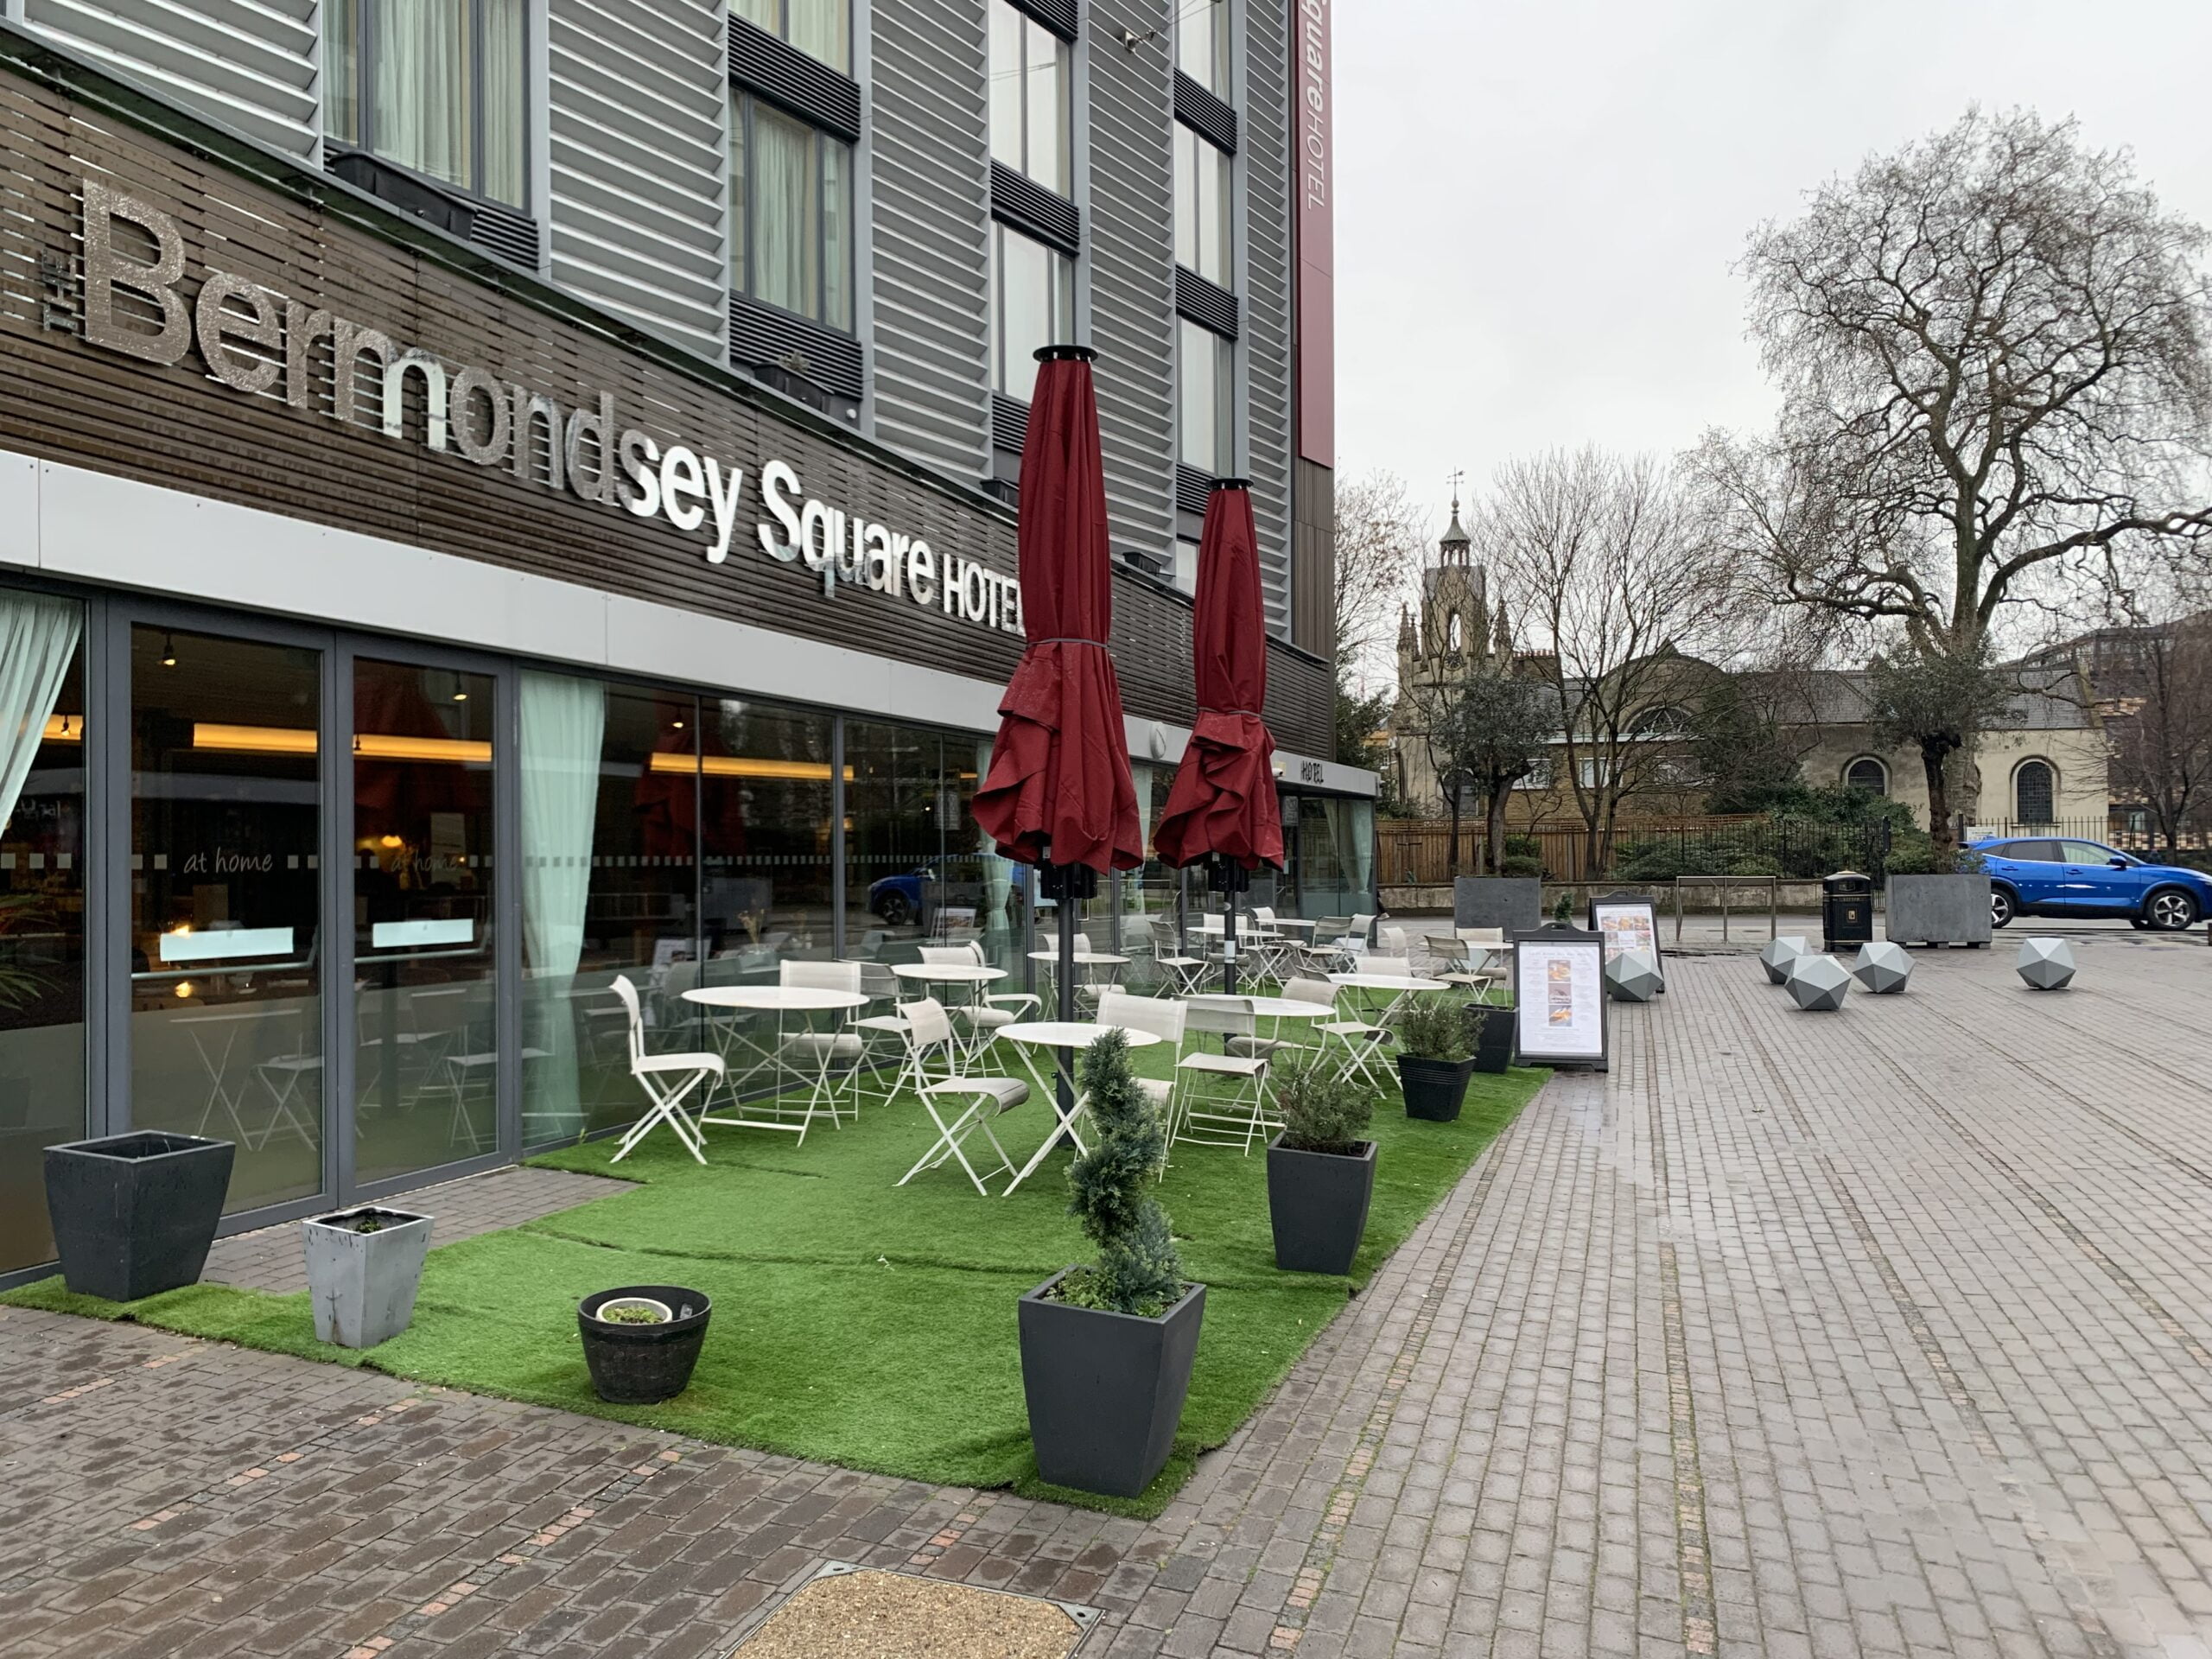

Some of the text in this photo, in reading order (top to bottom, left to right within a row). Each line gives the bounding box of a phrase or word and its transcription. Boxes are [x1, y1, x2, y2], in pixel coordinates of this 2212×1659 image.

[1301, 0, 1326, 112] quare
[41, 177, 1027, 637] THE Bermondsey Square HOTEL
[1300, 760, 1324, 784] HOTEL
[183, 846, 273, 874] at home
[415, 849, 458, 872] home
